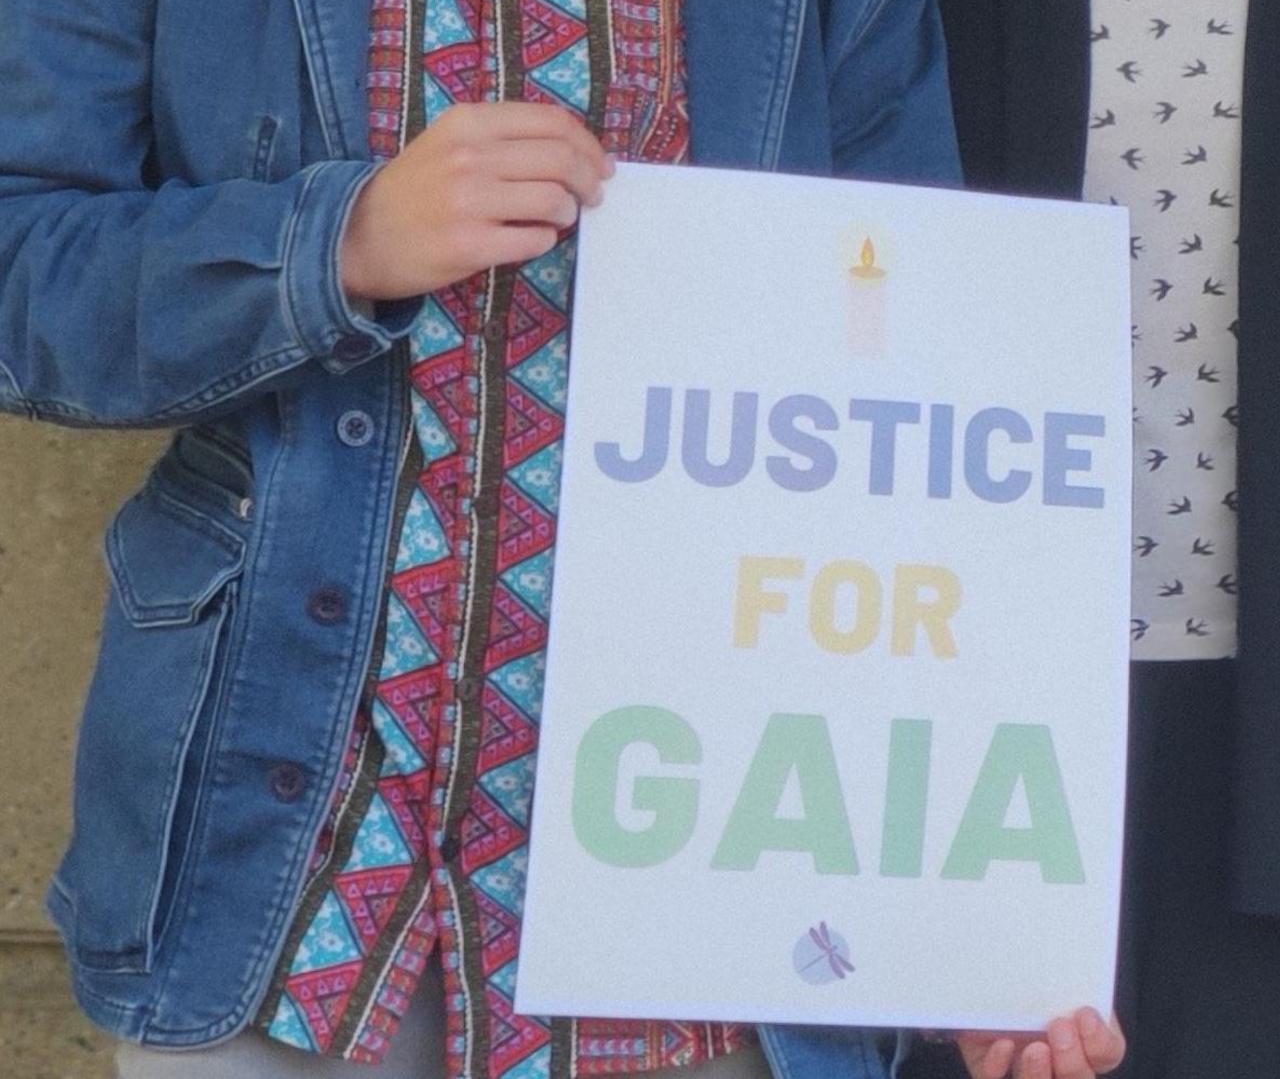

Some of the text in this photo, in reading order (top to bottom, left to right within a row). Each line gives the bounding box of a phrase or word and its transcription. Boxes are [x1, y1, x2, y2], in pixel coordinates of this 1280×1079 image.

[593, 385, 1107, 509] JUSTICE
[733, 555, 963, 660] FOR
[570, 704, 1087, 886] GAIA
